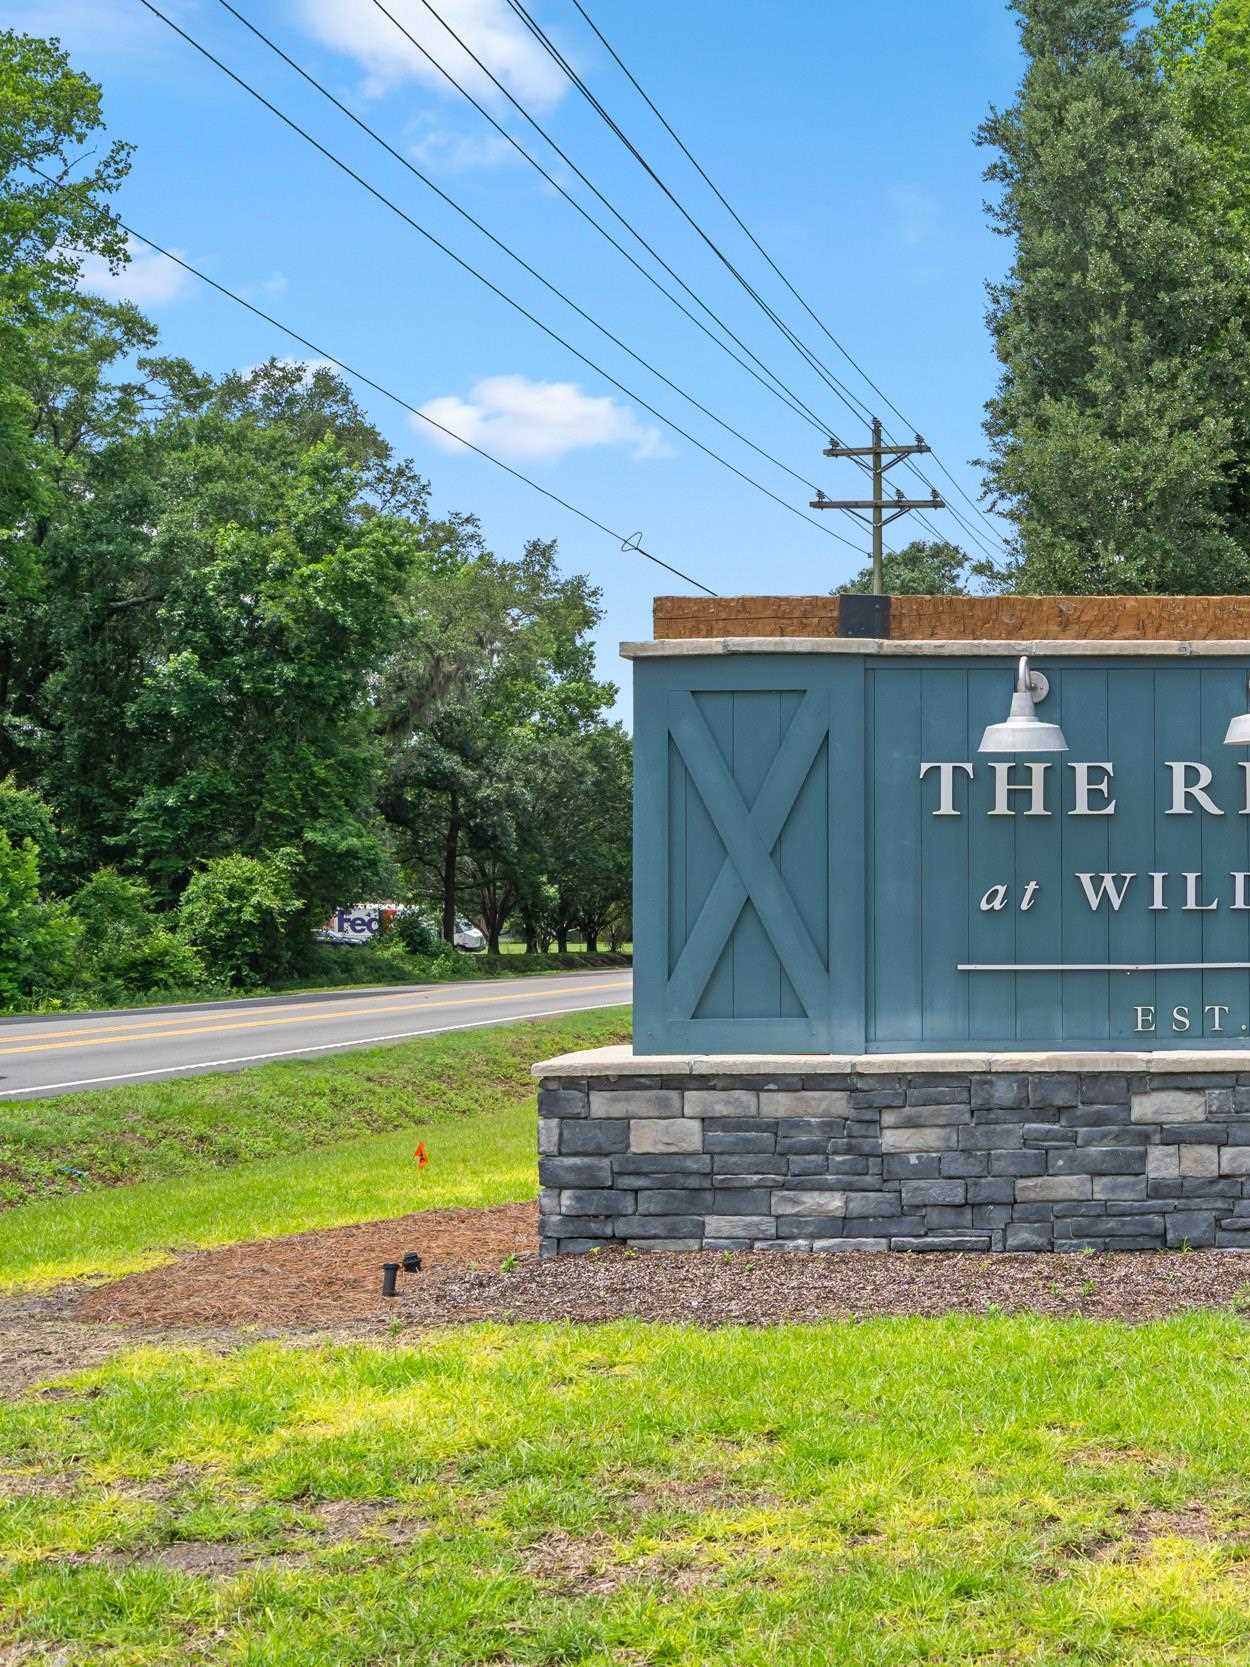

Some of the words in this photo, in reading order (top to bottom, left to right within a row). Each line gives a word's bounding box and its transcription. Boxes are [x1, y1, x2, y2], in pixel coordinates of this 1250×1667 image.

[919, 761, 1117, 816] THE
[979, 880, 1040, 911] at
[1133, 1005, 1248, 1032] EST.
